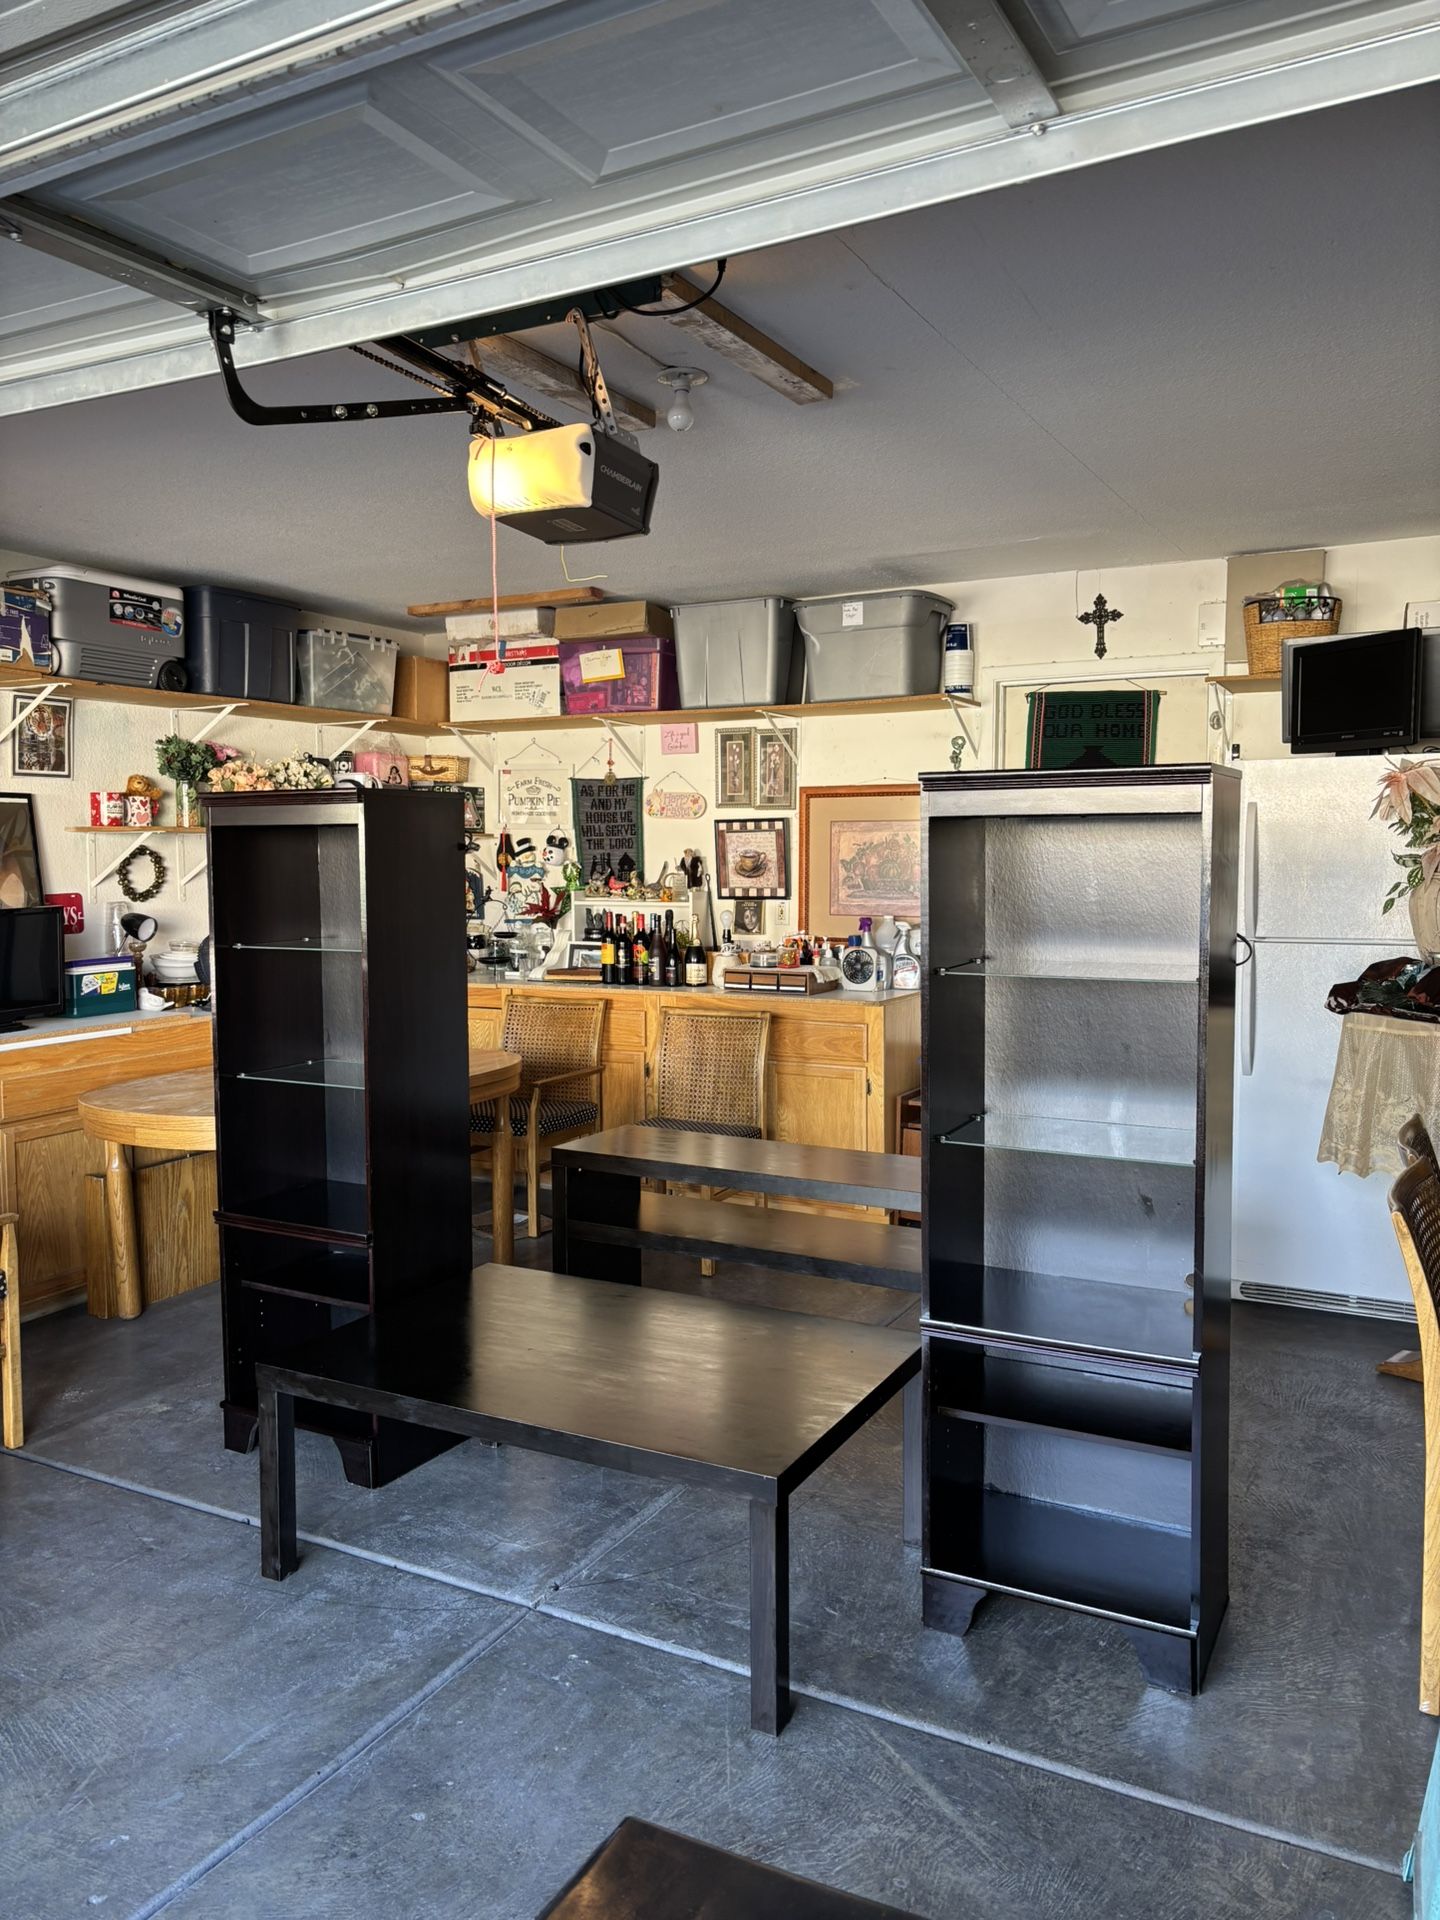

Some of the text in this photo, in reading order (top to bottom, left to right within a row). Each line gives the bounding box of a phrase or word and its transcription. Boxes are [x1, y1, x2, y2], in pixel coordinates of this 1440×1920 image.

[600, 464, 643, 492] CHAMBERLAIN
[1044, 703, 1145, 719] GOD BLESS
[1043, 723, 1145, 738] OUR HOME
[515, 777, 553, 790] FARM FRESH
[580, 784, 636, 797] AS FOR ME
[508, 793, 561, 807] PUMPKIN PIE
[590, 798, 628, 811] AND MY
[585, 811, 633, 824] HOUSE WE
[581, 824, 637, 837] WILL SERVE
[586, 838, 634, 850] THE LORD
